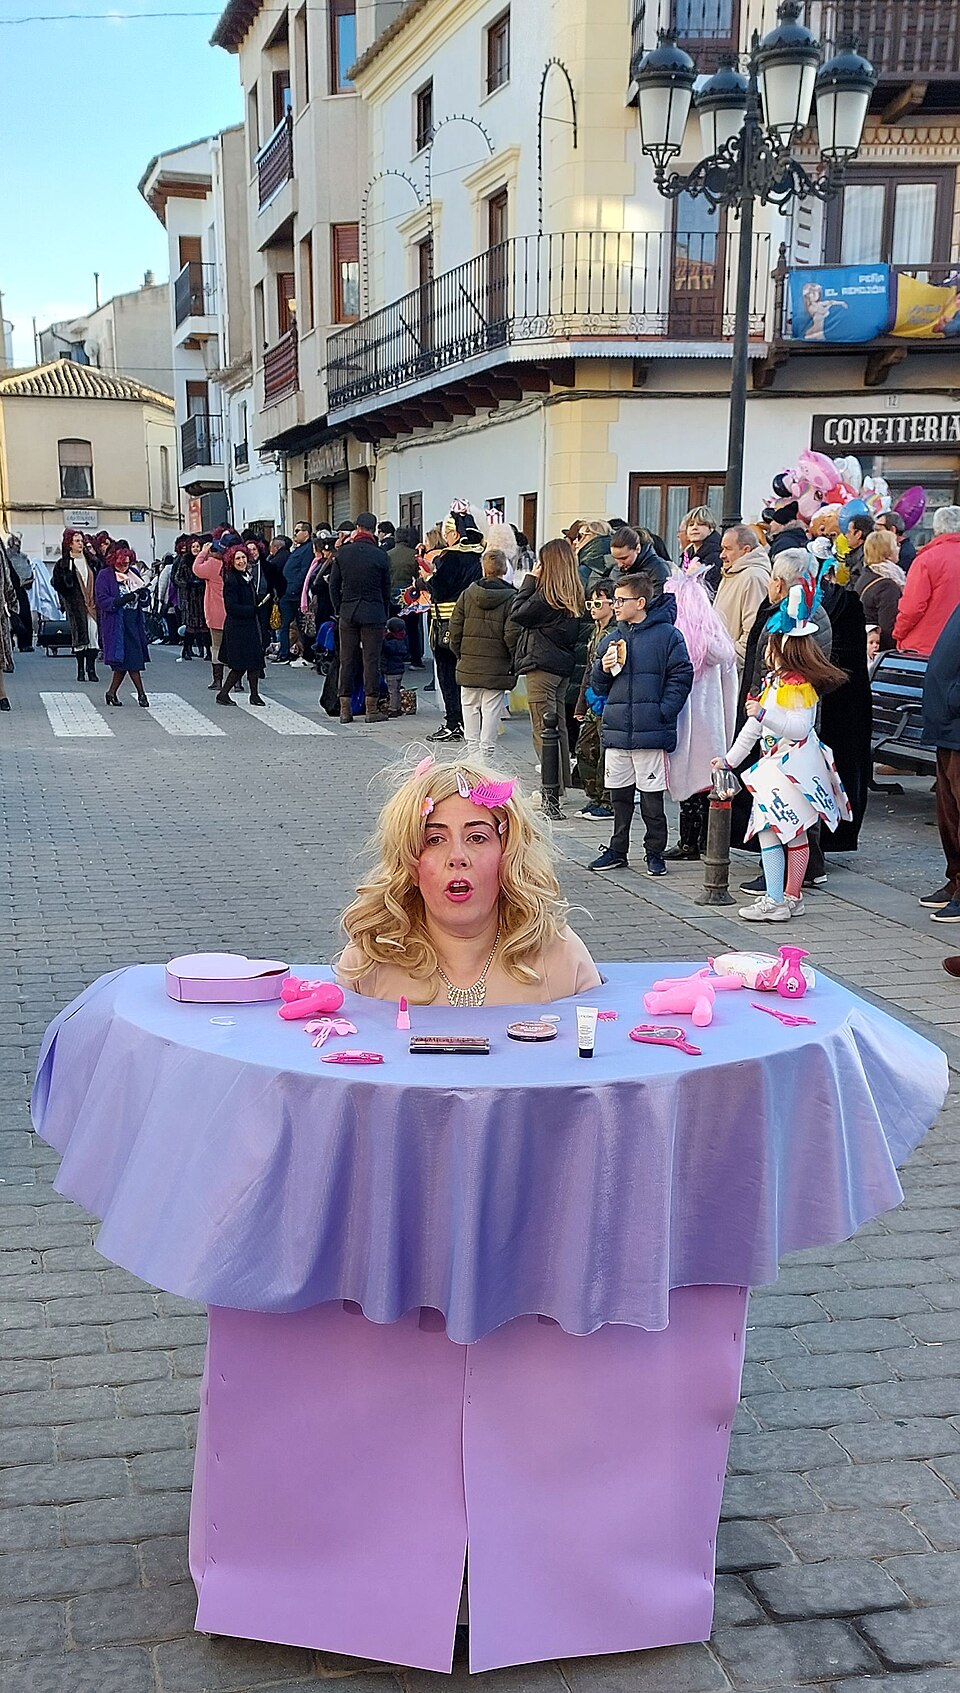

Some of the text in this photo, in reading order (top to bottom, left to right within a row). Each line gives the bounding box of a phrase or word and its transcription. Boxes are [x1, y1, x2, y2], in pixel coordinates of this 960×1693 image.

[858, 273, 885, 283] PEÑA
[824, 288, 839, 297] EL
[824, 415, 960, 445] CONFITERIA
